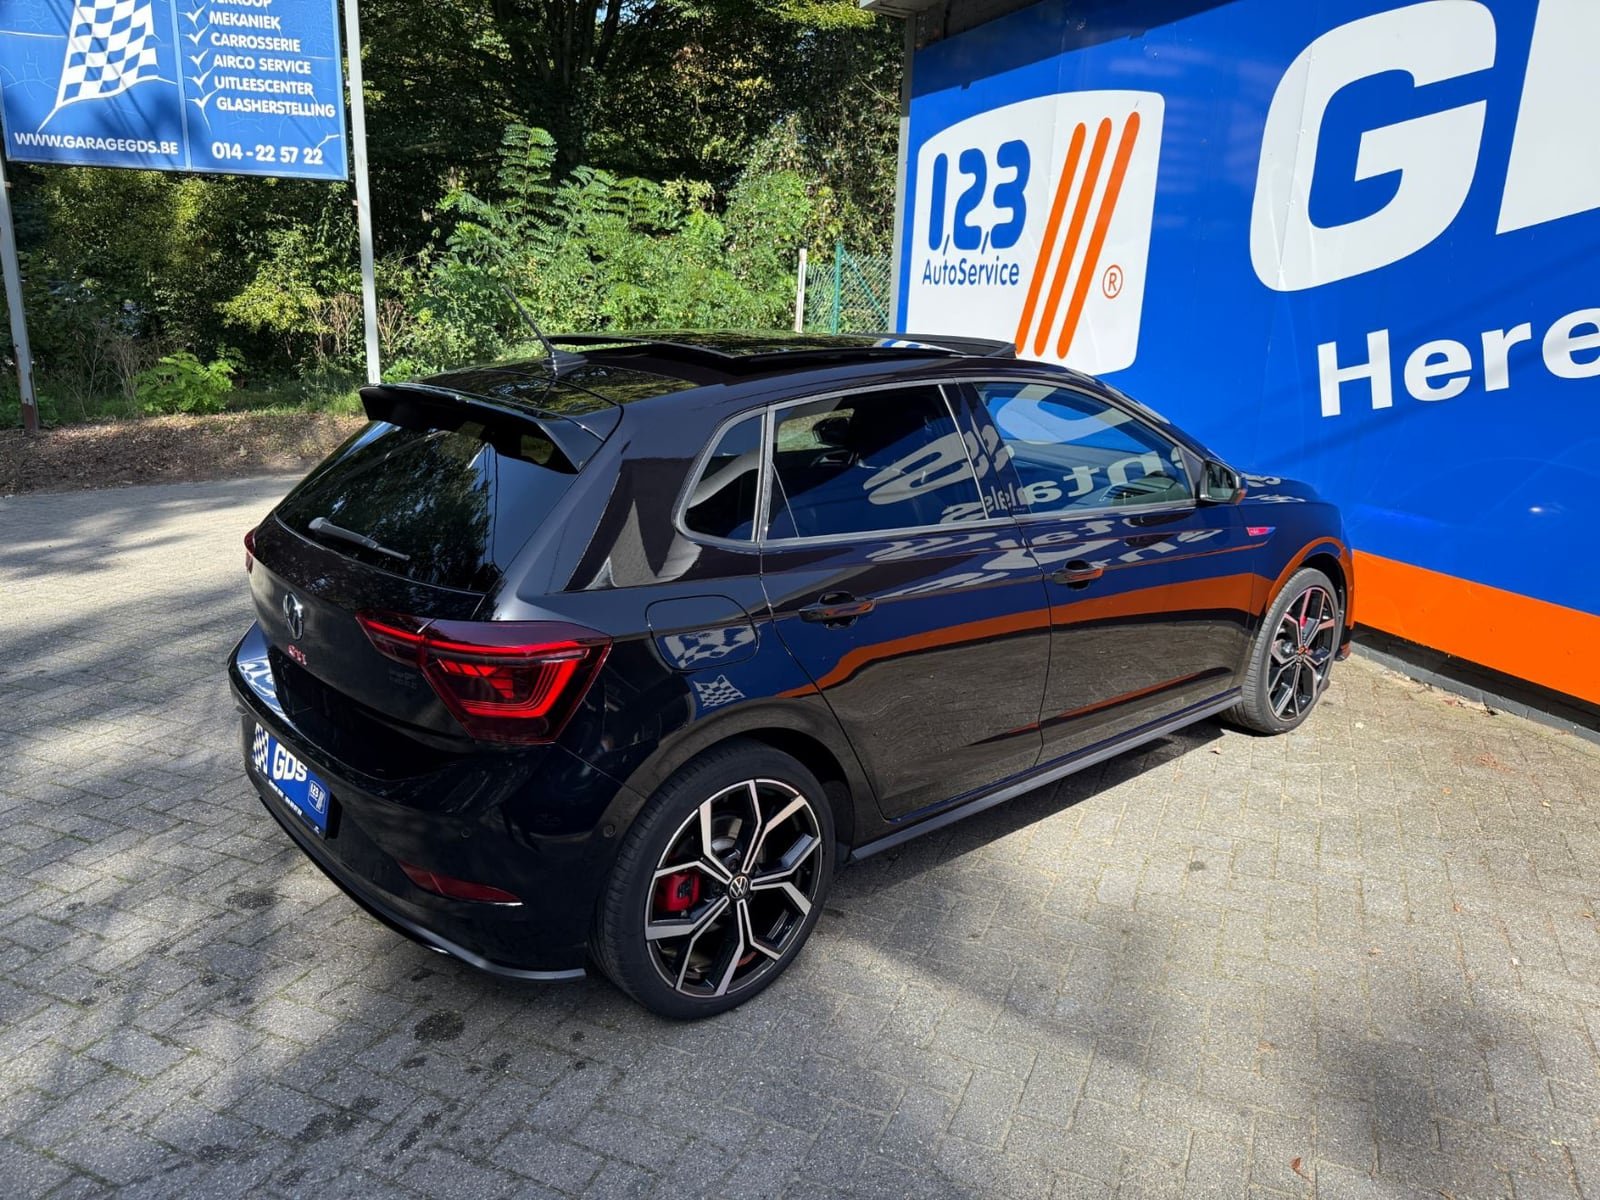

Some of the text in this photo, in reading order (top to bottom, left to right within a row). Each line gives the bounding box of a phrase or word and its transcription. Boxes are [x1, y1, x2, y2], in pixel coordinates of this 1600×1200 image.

[210, 11, 280, 29] MEKANIEK
[210, 32, 301, 52] CARROSSERIE
[213, 54, 312, 74] AIRCO SERVICE
[214, 77, 314, 96] UITLEESCENTER
[216, 97, 336, 118] GLASHERSTELLING
[14, 132, 179, 155] WWW.GARAGEGDS.BE
[212, 141, 244, 161] 014
[256, 145, 276, 163] 22
[280, 146, 298, 164] 57
[303, 147, 324, 166] 22
[922, 256, 1020, 286] AutoService
[273, 743, 307, 782] GDS
